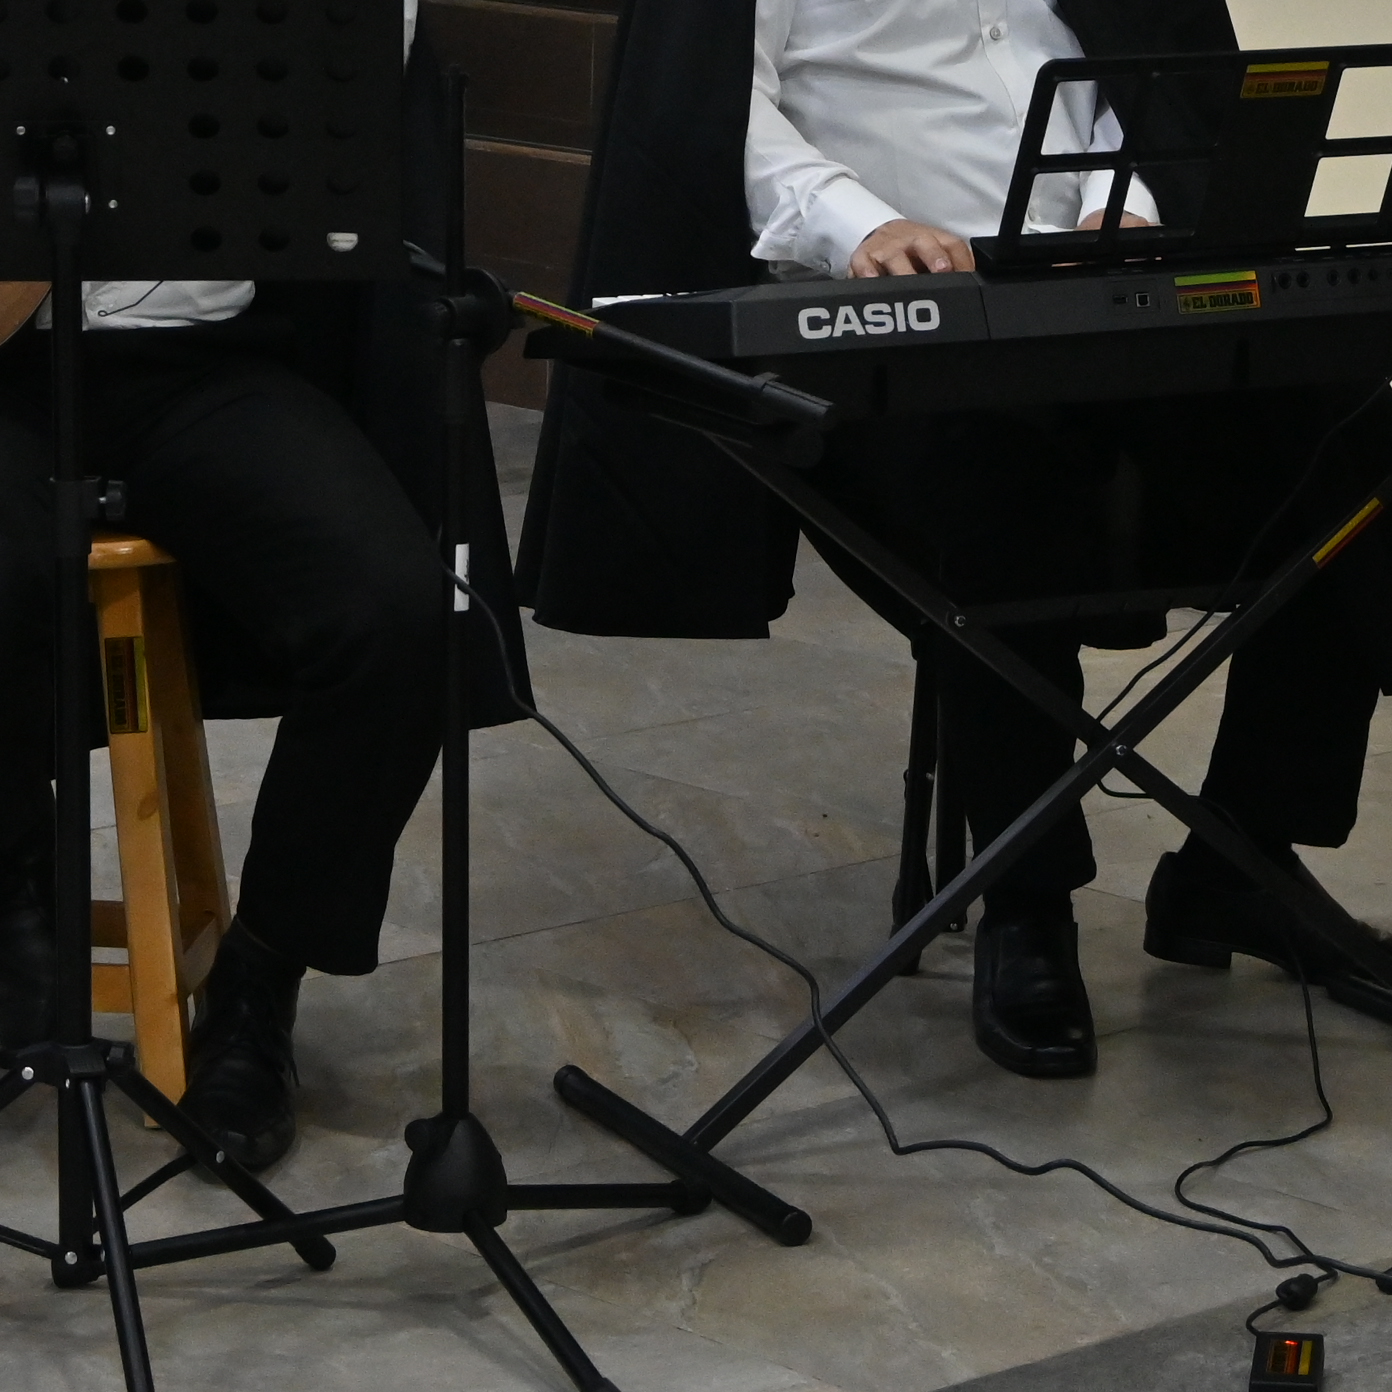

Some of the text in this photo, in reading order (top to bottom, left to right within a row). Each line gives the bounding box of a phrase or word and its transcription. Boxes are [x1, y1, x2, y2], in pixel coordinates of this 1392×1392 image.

[1192, 291, 1254, 309] EL DORADO
[797, 298, 941, 340] CASIO
